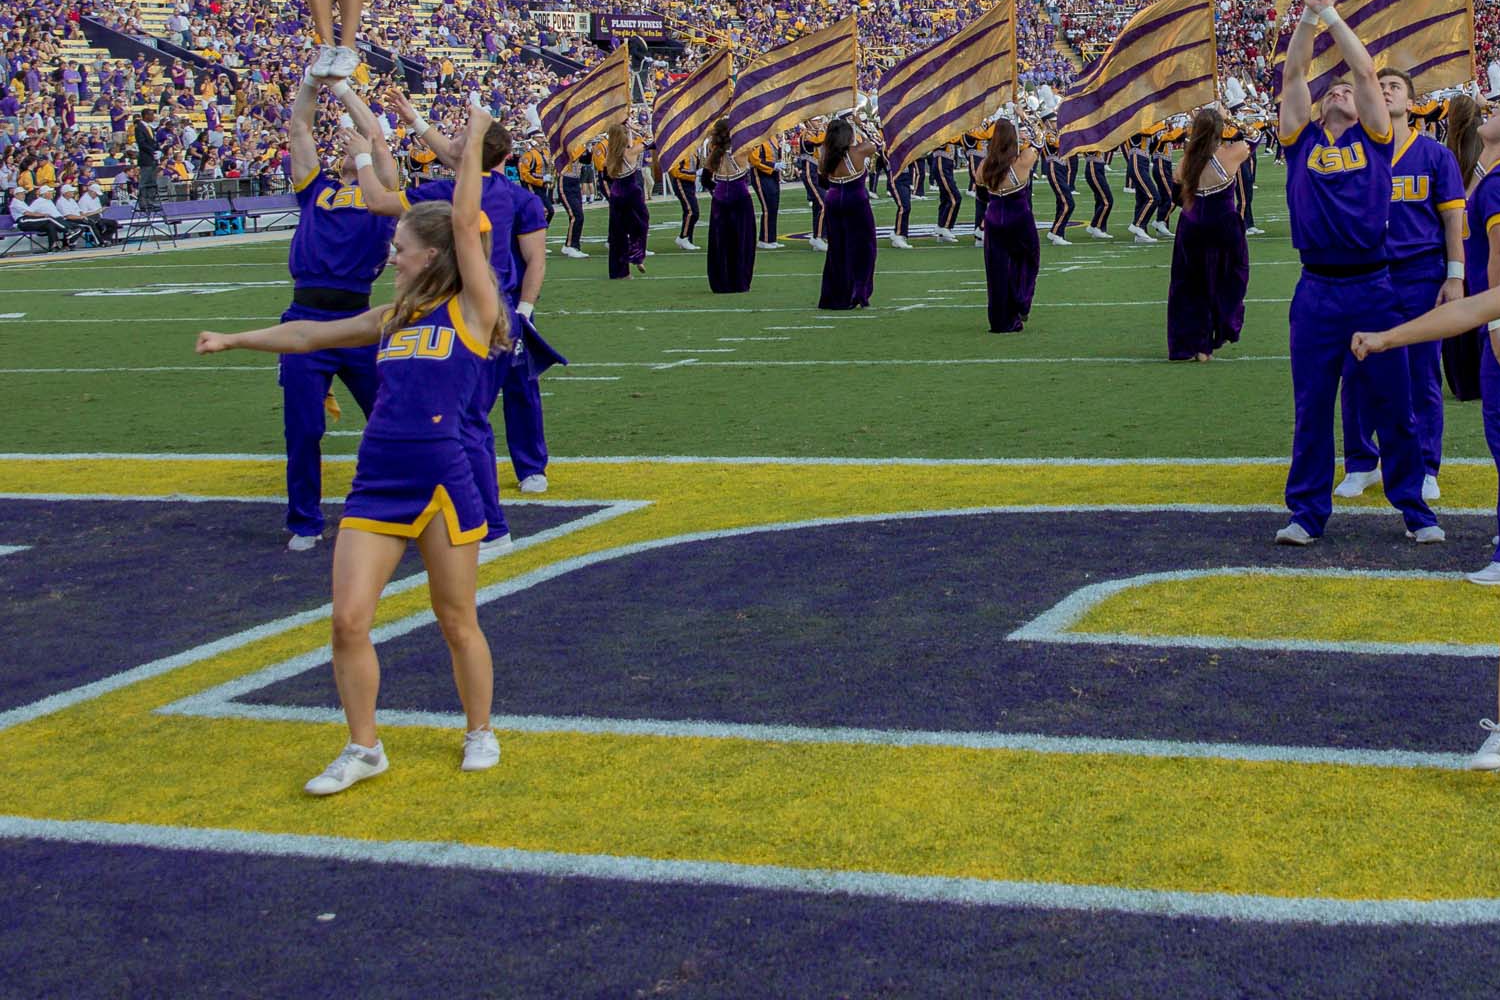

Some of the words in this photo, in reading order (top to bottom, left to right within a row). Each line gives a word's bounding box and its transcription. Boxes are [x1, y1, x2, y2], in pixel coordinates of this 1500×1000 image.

[553, 14, 575, 30] POWER
[611, 20, 636, 28] PLANET
[638, 20, 662, 28] FITNESS
[1307, 142, 1367, 175] LSU
